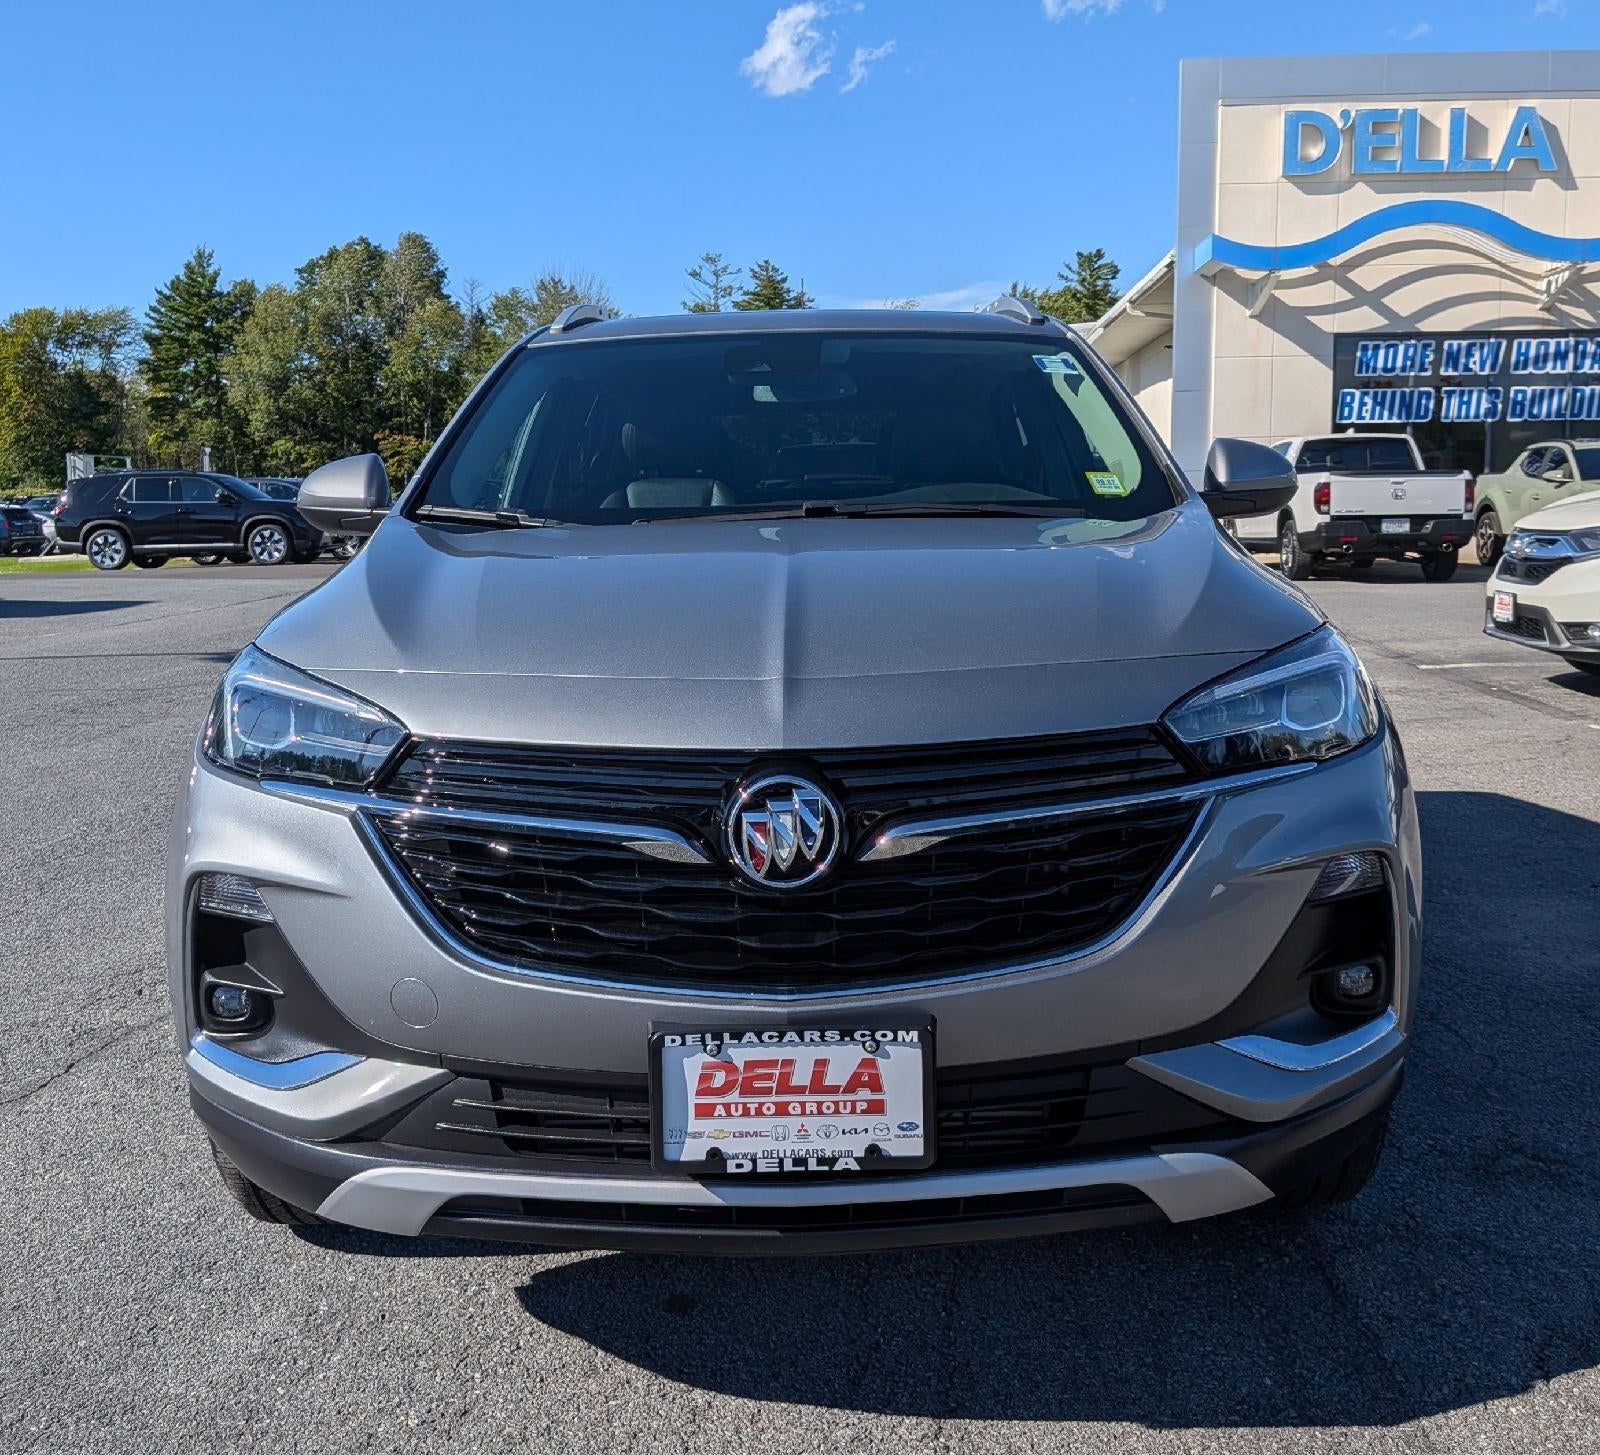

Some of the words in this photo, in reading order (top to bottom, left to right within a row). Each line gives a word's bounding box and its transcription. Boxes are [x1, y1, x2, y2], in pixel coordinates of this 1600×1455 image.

[1282, 106, 1557, 176] D'ELLA
[1355, 340, 1436, 376] MORE
[1440, 339, 1507, 375] NEW
[1336, 387, 1435, 423] BEHIND
[1440, 387, 1503, 422] THIS
[1507, 386, 1600, 422] BUILDI
[665, 1031, 919, 1047] DELLACARS.COM
[695, 1057, 885, 1098] DELLA
[713, 1103, 776, 1117] AUTO
[788, 1101, 868, 1115] GROUP
[733, 1130, 771, 1138] GMC
[731, 1148, 854, 1159] www.DELLACARS.com
[726, 1157, 861, 1173] DELLA
